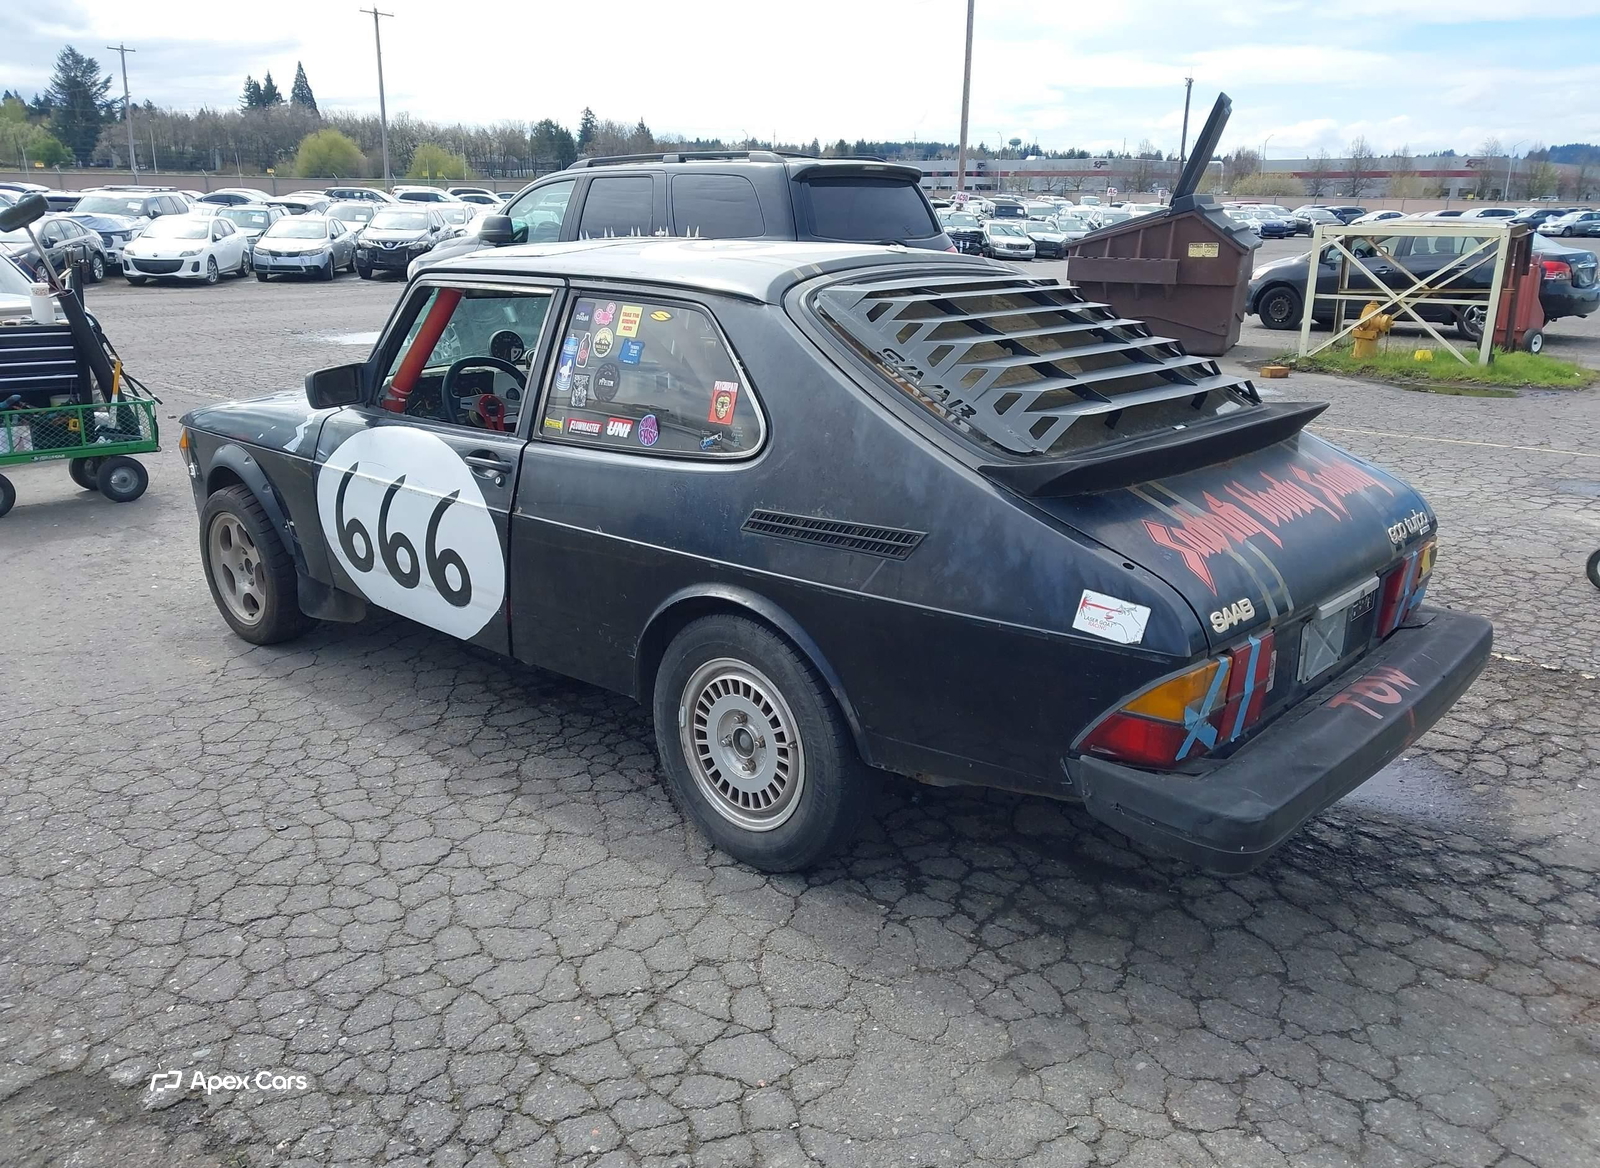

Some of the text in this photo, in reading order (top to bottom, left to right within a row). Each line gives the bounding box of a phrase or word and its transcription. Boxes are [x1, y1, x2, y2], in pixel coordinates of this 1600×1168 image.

[569, 420, 601, 433] FLOWMASTER
[335, 461, 473, 609] 666
[1388, 522, 1407, 545] 900
[1403, 509, 1428, 534] turbo
[1084, 615, 1114, 628] LASER GOAT
[1087, 620, 1107, 631] RACING
[1210, 597, 1256, 634] SAAB
[1326, 665, 1420, 720] TOW
